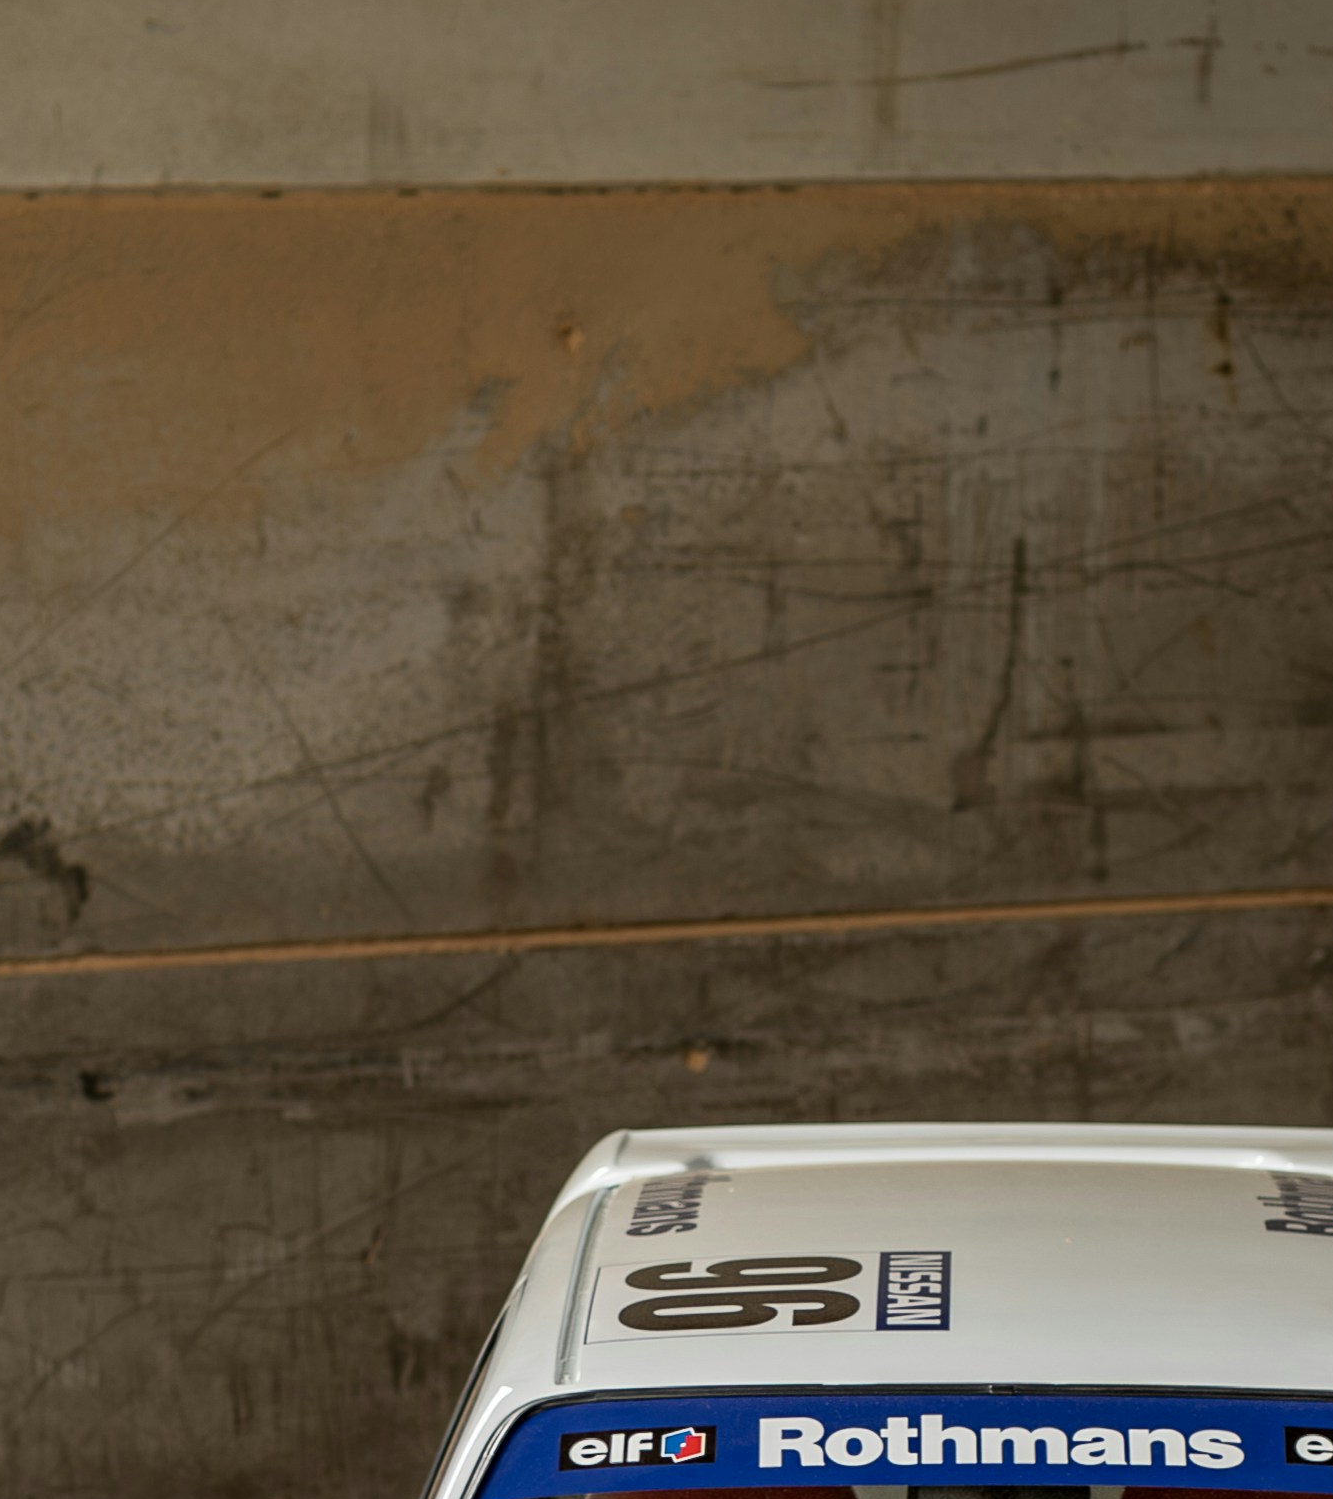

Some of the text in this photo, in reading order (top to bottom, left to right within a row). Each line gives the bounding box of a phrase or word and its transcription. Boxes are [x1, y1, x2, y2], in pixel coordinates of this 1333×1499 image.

[618, 1256, 863, 1331] 96
[886, 1254, 944, 1326] NISSAN
[568, 1432, 654, 1466] elf
[758, 1414, 1245, 1469] Rothmans
